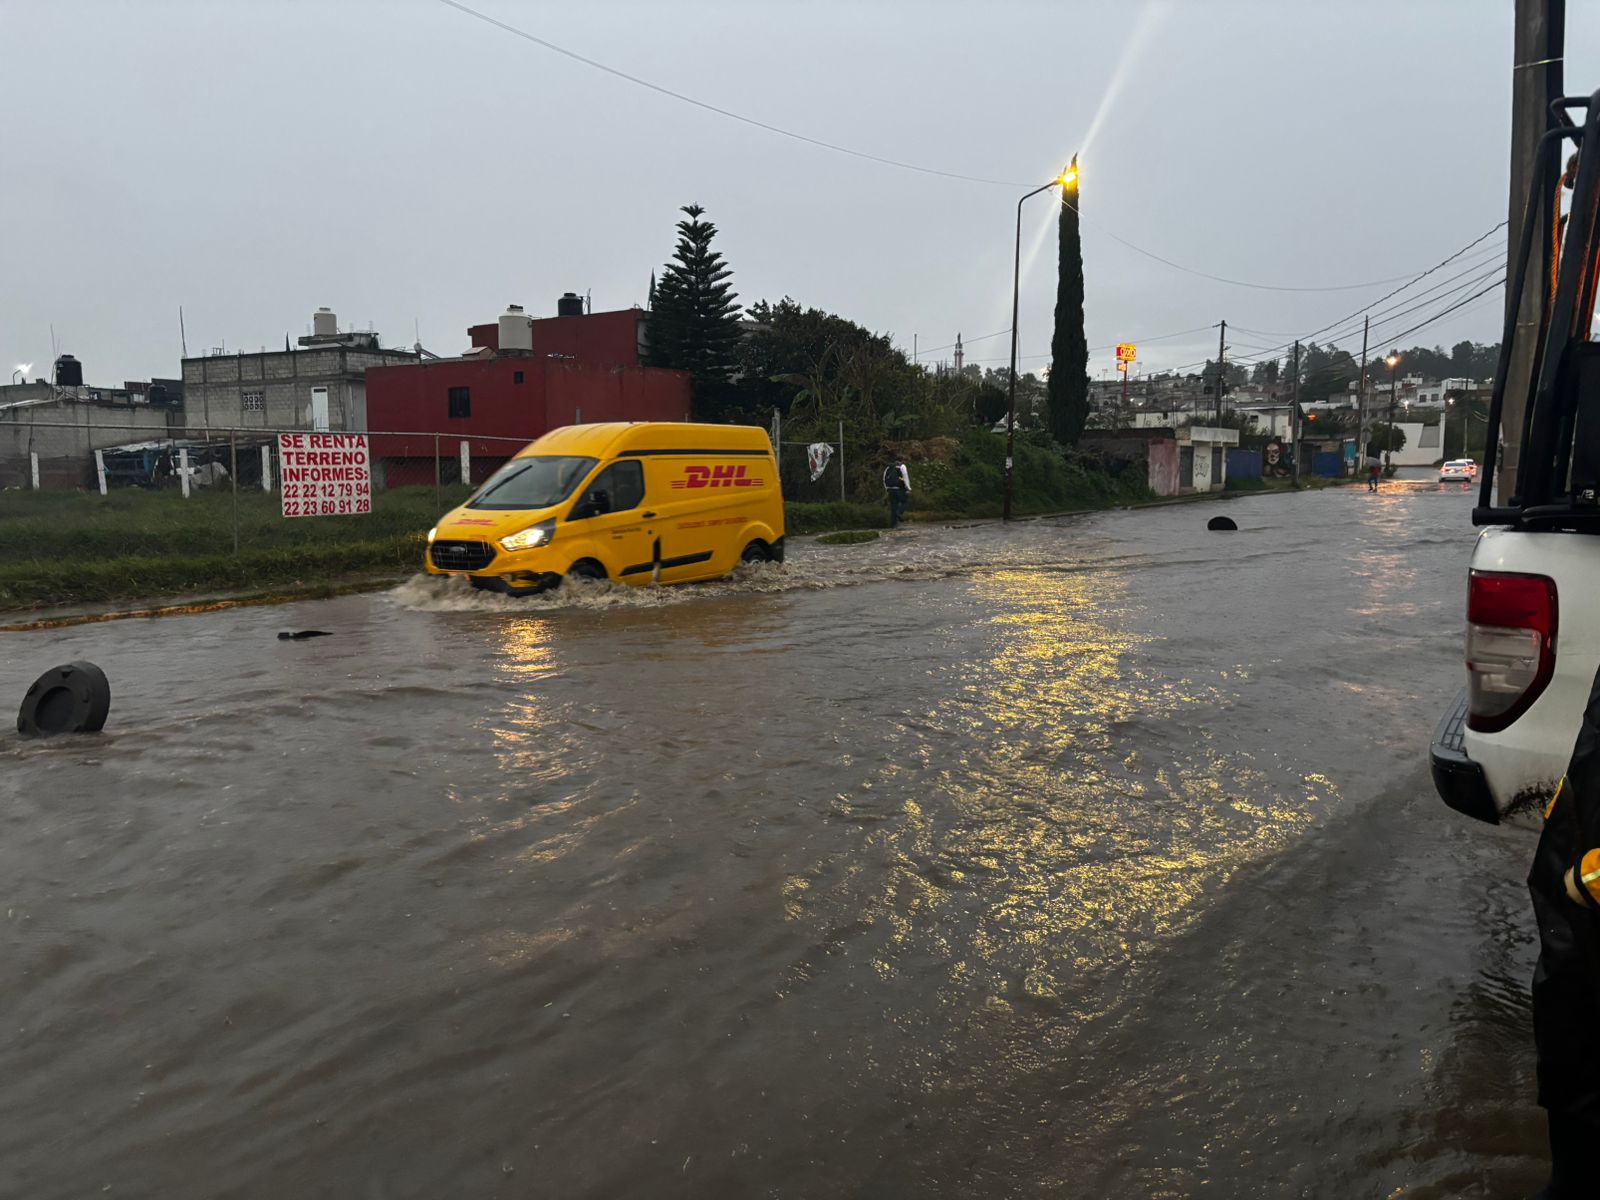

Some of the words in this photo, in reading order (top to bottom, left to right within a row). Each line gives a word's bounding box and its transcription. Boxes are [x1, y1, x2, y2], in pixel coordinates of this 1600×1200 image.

[280, 434, 304, 448] SE
[309, 434, 366, 449] RENTA
[282, 451, 366, 465] TERRENO
[282, 467, 368, 482] INFORMES:
[683, 465, 754, 488] DHL
[283, 484, 299, 498] 22
[302, 484, 317, 498] 22
[321, 483, 335, 497] 12
[338, 483, 352, 497] 79
[356, 482, 369, 496] 94
[284, 501, 299, 516] 22
[303, 501, 318, 515] 23
[321, 500, 335, 514] 60
[339, 500, 352, 513] 91
[356, 499, 370, 513] 28
